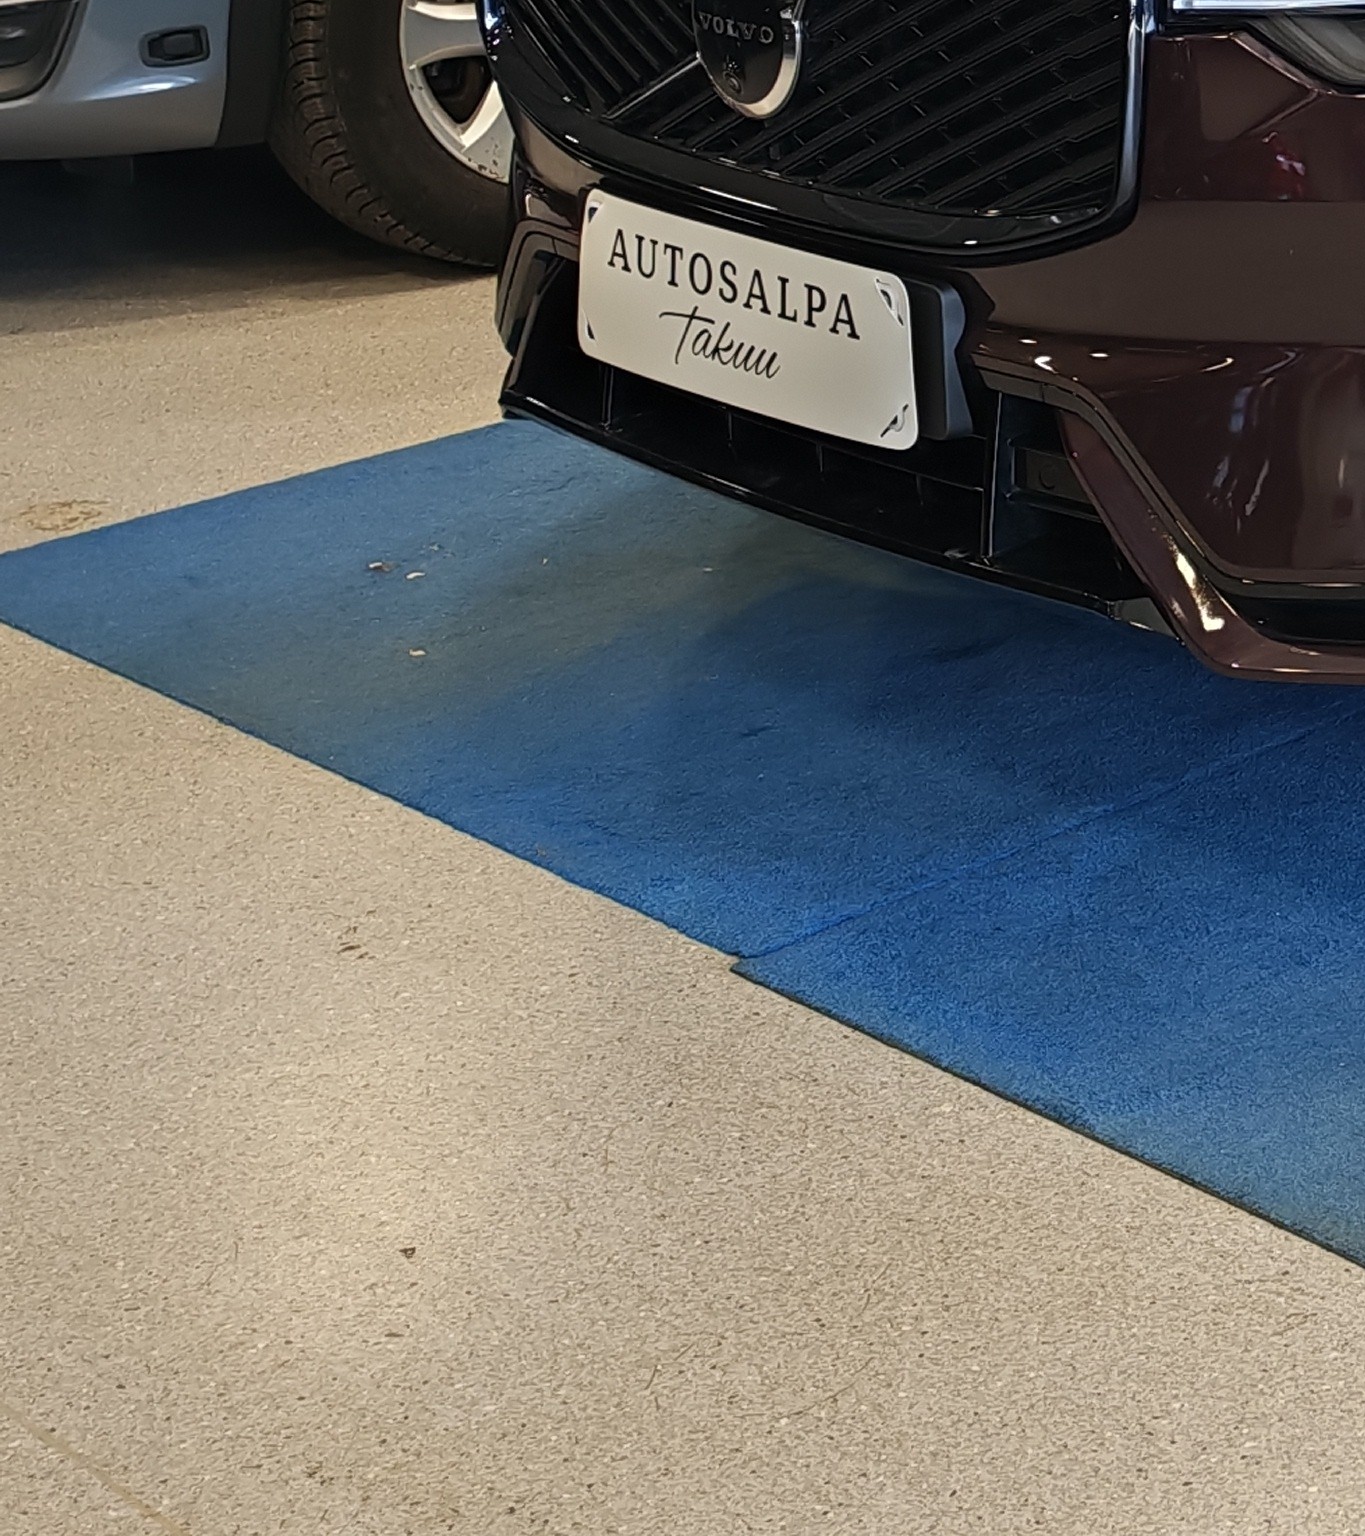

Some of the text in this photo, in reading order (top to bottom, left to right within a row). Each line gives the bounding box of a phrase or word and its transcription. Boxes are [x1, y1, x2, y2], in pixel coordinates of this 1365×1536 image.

[698, 10, 774, 45] VOLVO
[606, 228, 861, 341] AUTOSALPA
[659, 305, 781, 379] Takuu
